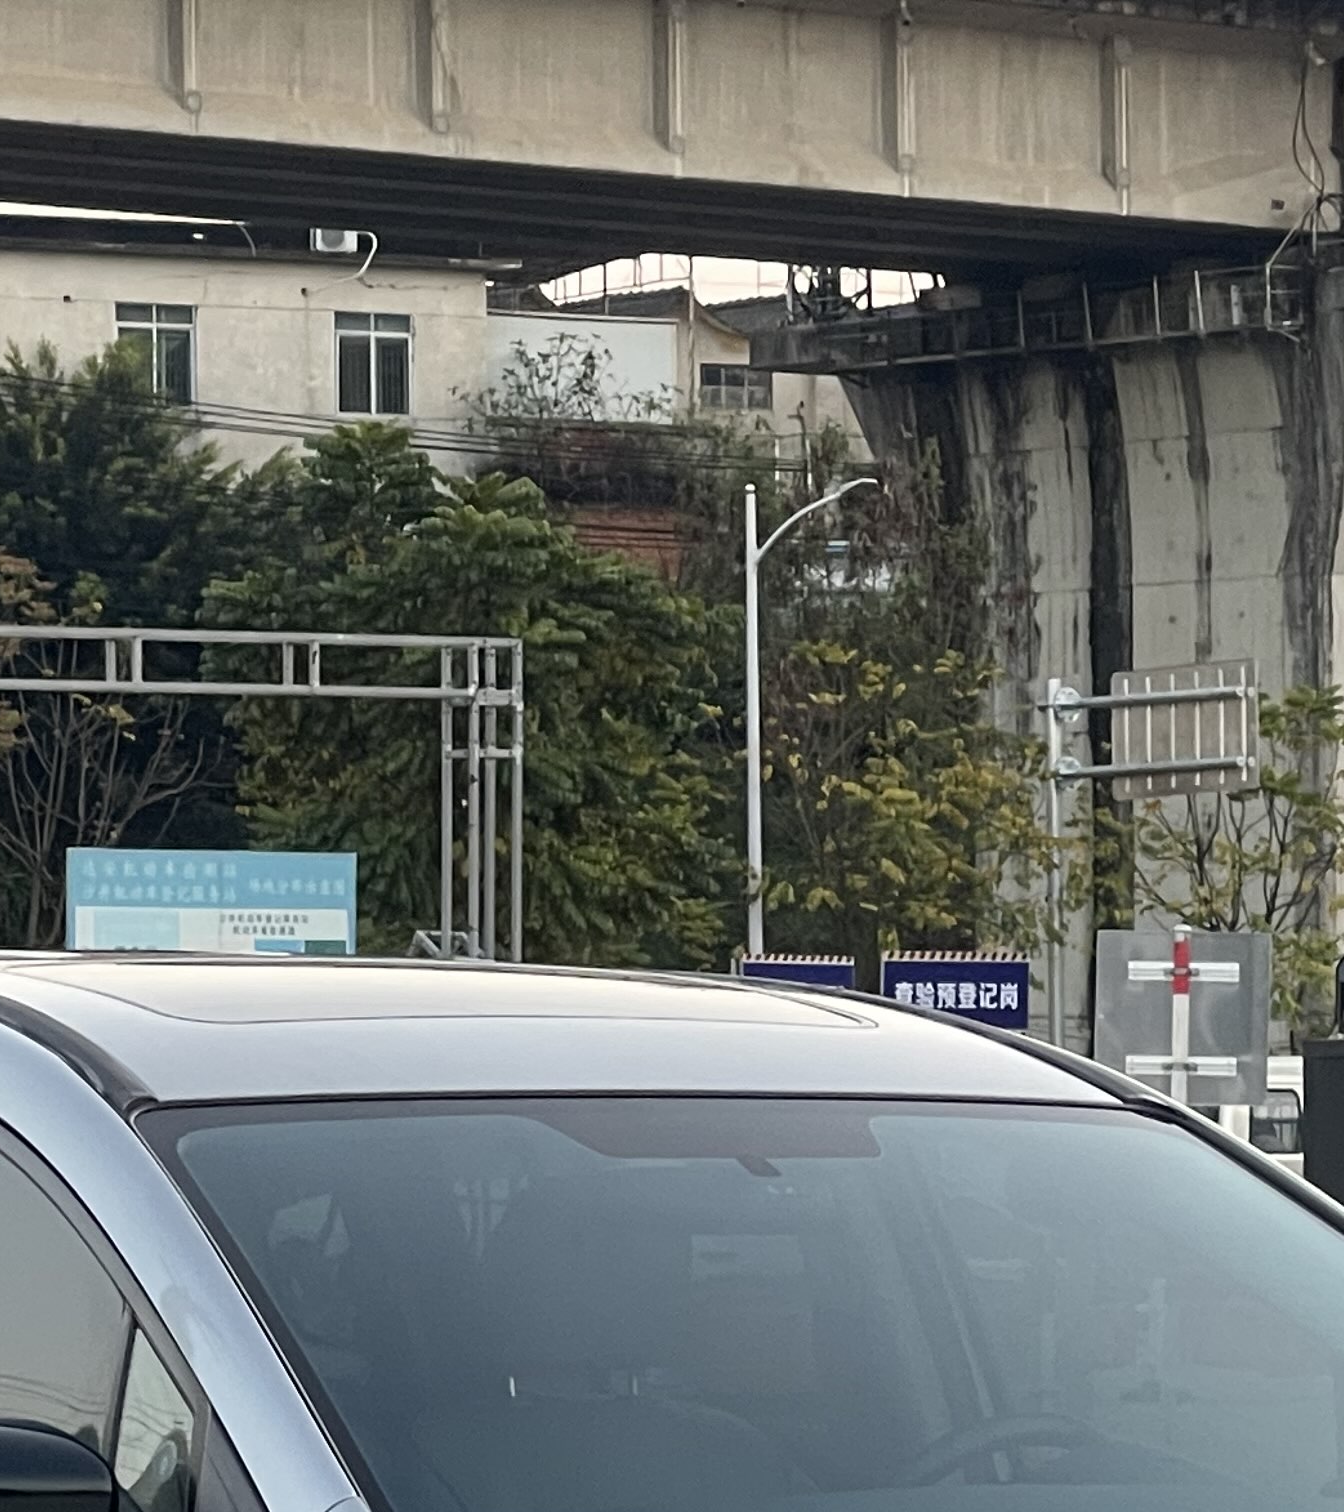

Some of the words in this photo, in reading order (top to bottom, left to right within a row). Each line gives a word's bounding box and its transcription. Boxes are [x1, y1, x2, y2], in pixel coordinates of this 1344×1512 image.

[895, 981, 1018, 1010] 查验预登记岗
